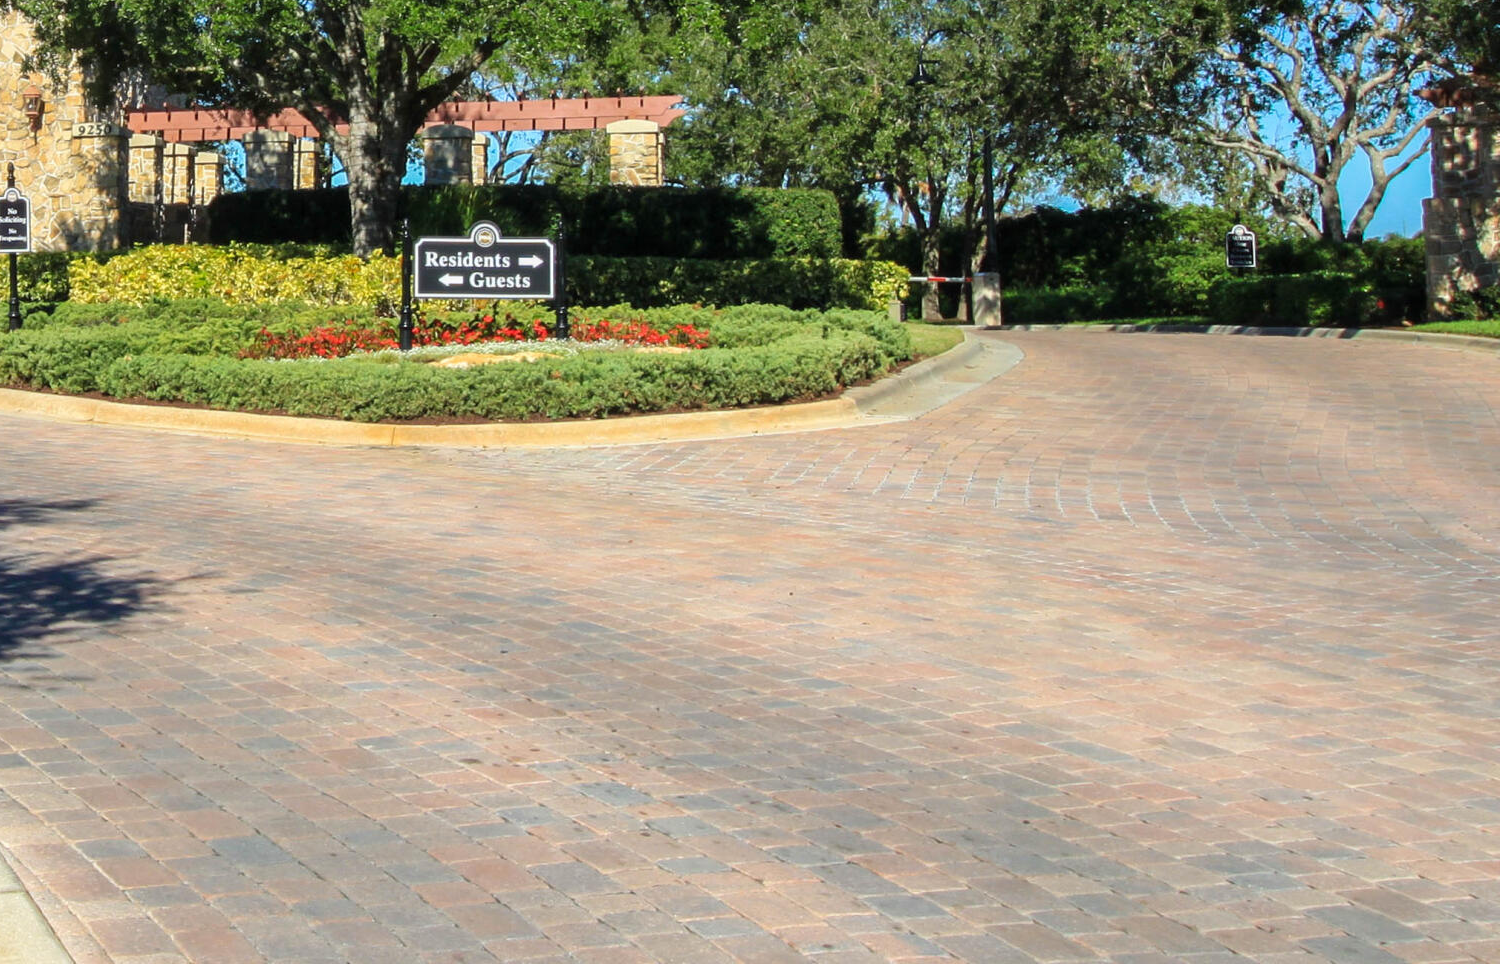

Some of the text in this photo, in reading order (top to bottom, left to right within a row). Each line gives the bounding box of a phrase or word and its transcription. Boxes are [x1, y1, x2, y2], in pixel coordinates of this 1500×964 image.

[78, 124, 111, 136] 9250
[425, 252, 510, 267] Residents
[469, 272, 531, 288] Guests
